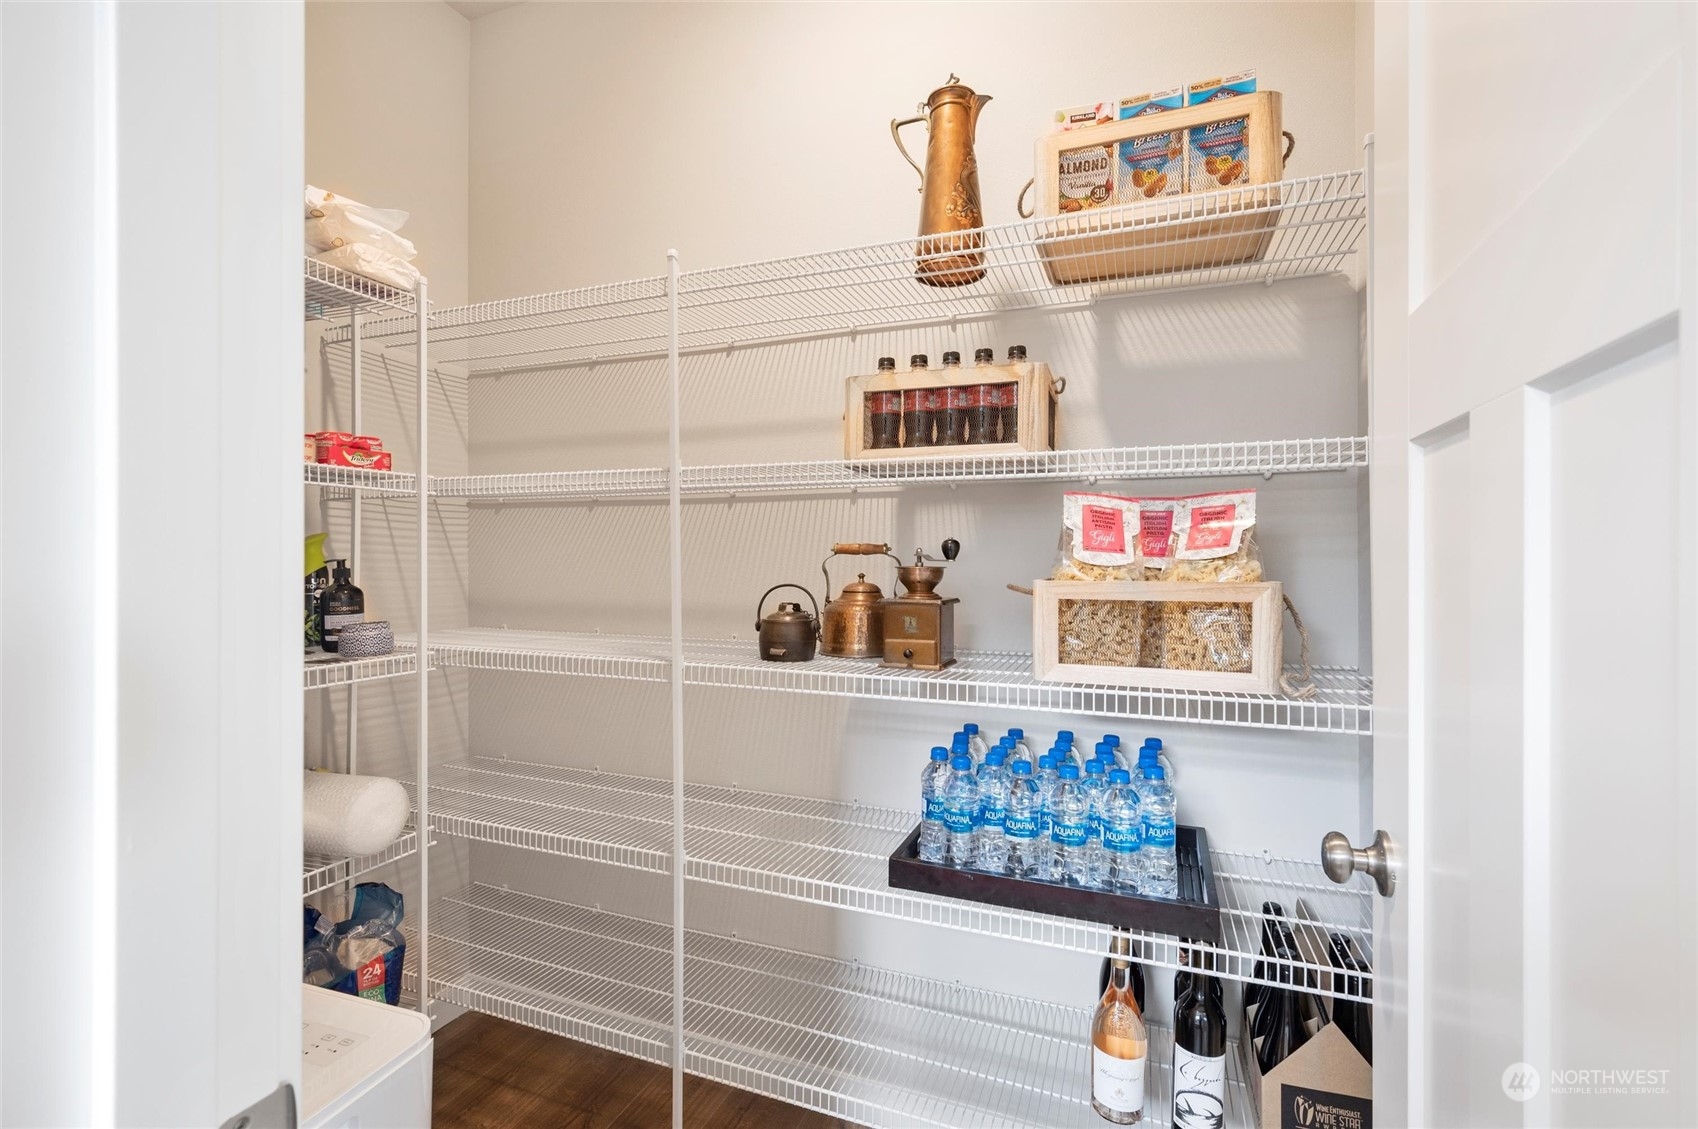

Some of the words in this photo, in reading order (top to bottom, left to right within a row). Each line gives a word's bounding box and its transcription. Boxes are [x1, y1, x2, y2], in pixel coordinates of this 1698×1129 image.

[1059, 157, 1108, 175] ALMOND
[1094, 188, 1105, 198] 30
[350, 455, 374, 463] Trident
[1090, 509, 1116, 518] ORGANIC
[1089, 530, 1115, 547] Gigli
[1142, 537, 1167, 552] Gigli
[928, 803, 945, 813] AQUA
[1005, 819, 1036, 831] AQUAFINA
[1053, 825, 1085, 837] AQUAFINA
[1105, 830, 1138, 842] AQUAFINA
[1148, 827, 1174, 837] AQUAFIN
[363, 963, 382, 980] 24
[1315, 1104, 1329, 1112] WINE
[1329, 1106, 1361, 1119] ENTHUSIAST
[1315, 1111, 1337, 1126] WINE
[1338, 1115, 1361, 1129] STAR
